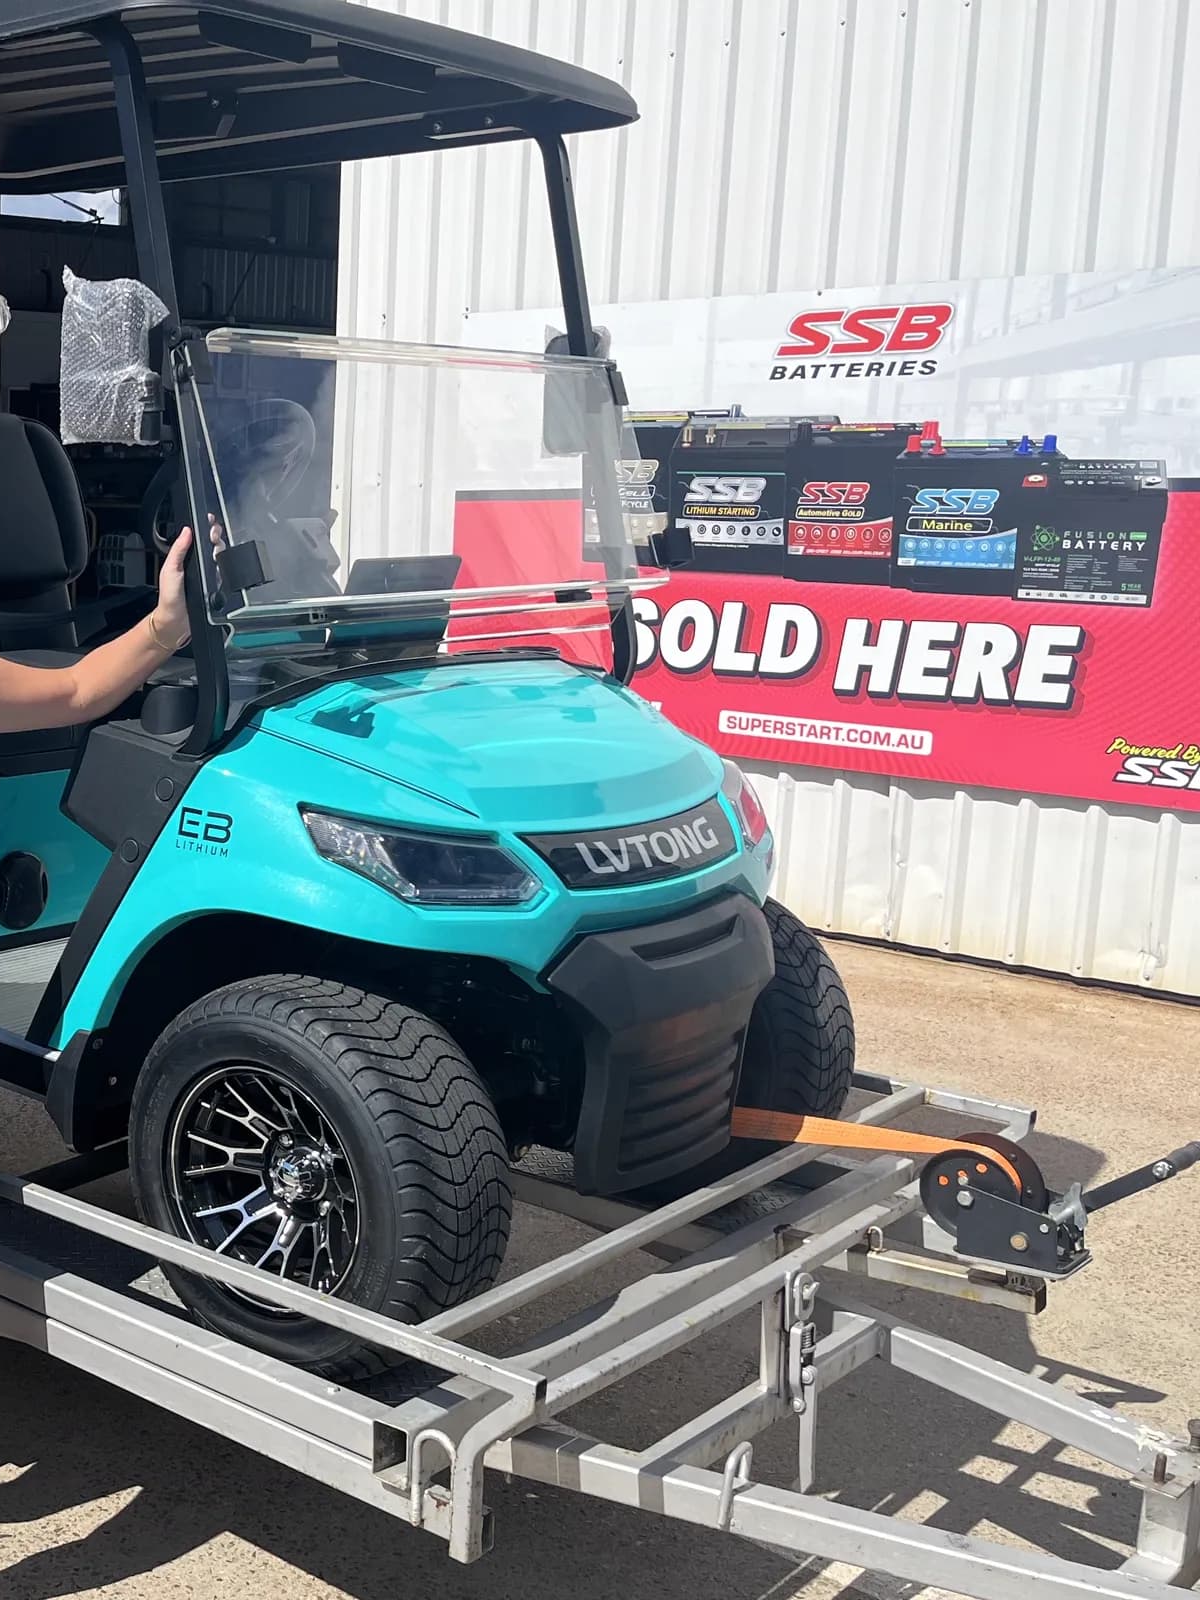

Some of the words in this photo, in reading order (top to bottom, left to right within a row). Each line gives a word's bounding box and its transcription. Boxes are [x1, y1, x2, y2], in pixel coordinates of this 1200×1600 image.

[775, 303, 955, 358] SSB
[769, 359, 939, 381] BATTERIES
[684, 477, 768, 503] SSB
[798, 481, 871, 505] SSB
[909, 488, 1000, 515] SSB
[686, 506, 718, 515] LITHIUM
[717, 507, 757, 516] STARTING
[798, 509, 840, 517] Automotive
[922, 518, 973, 531] Marine
[1063, 530, 1127, 540] FUSION
[1062, 540, 1146, 551] BATTERY
[1121, 583, 1127, 592] 5
[634, 597, 820, 678] SOLD
[834, 616, 1085, 707] HERE
[726, 714, 925, 751] SUPERSTART.COM.AU
[1105, 736, 1184, 758] Powered
[1181, 744, 1200, 765] By
[178, 806, 234, 844] EB
[175, 839, 229, 858] LITHIUM
[574, 816, 720, 875] LVTONG
